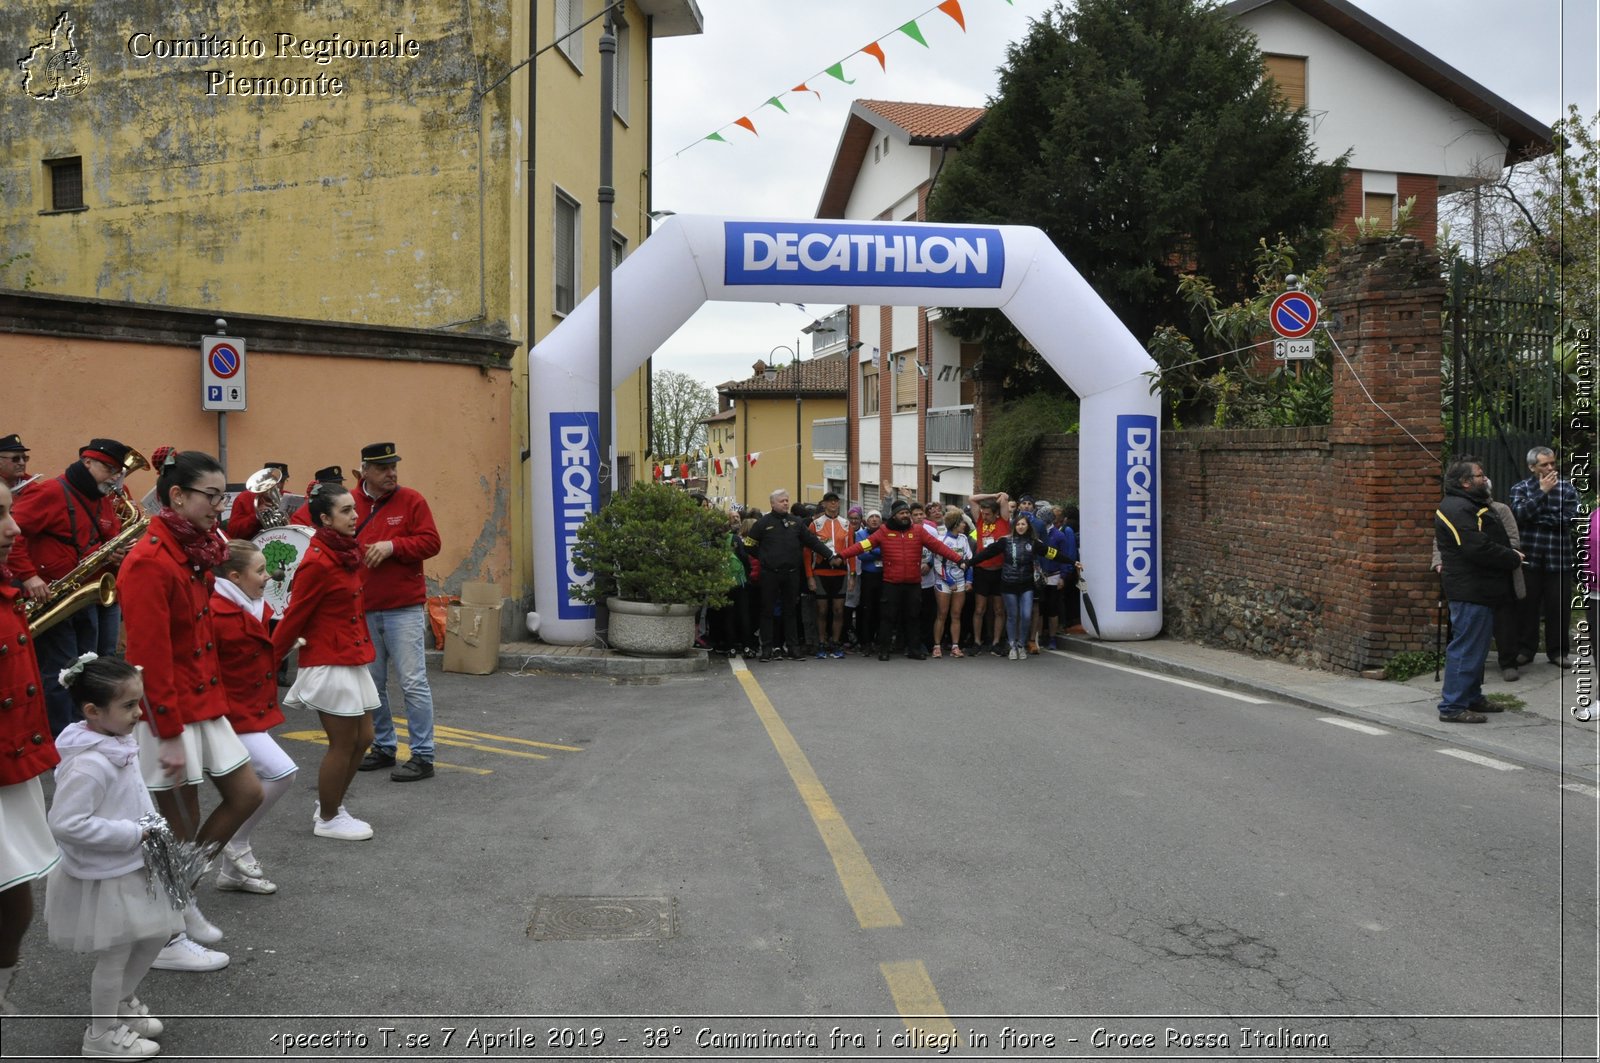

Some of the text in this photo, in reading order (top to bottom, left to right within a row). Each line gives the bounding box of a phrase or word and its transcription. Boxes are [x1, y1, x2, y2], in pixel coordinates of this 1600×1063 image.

[743, 233, 987, 274] DECATHLON
[1290, 345, 1310, 353] 0-24
[212, 388, 218, 399] P
[1126, 427, 1152, 599] DECATHLON
[259, 533, 287, 545] Musicale
